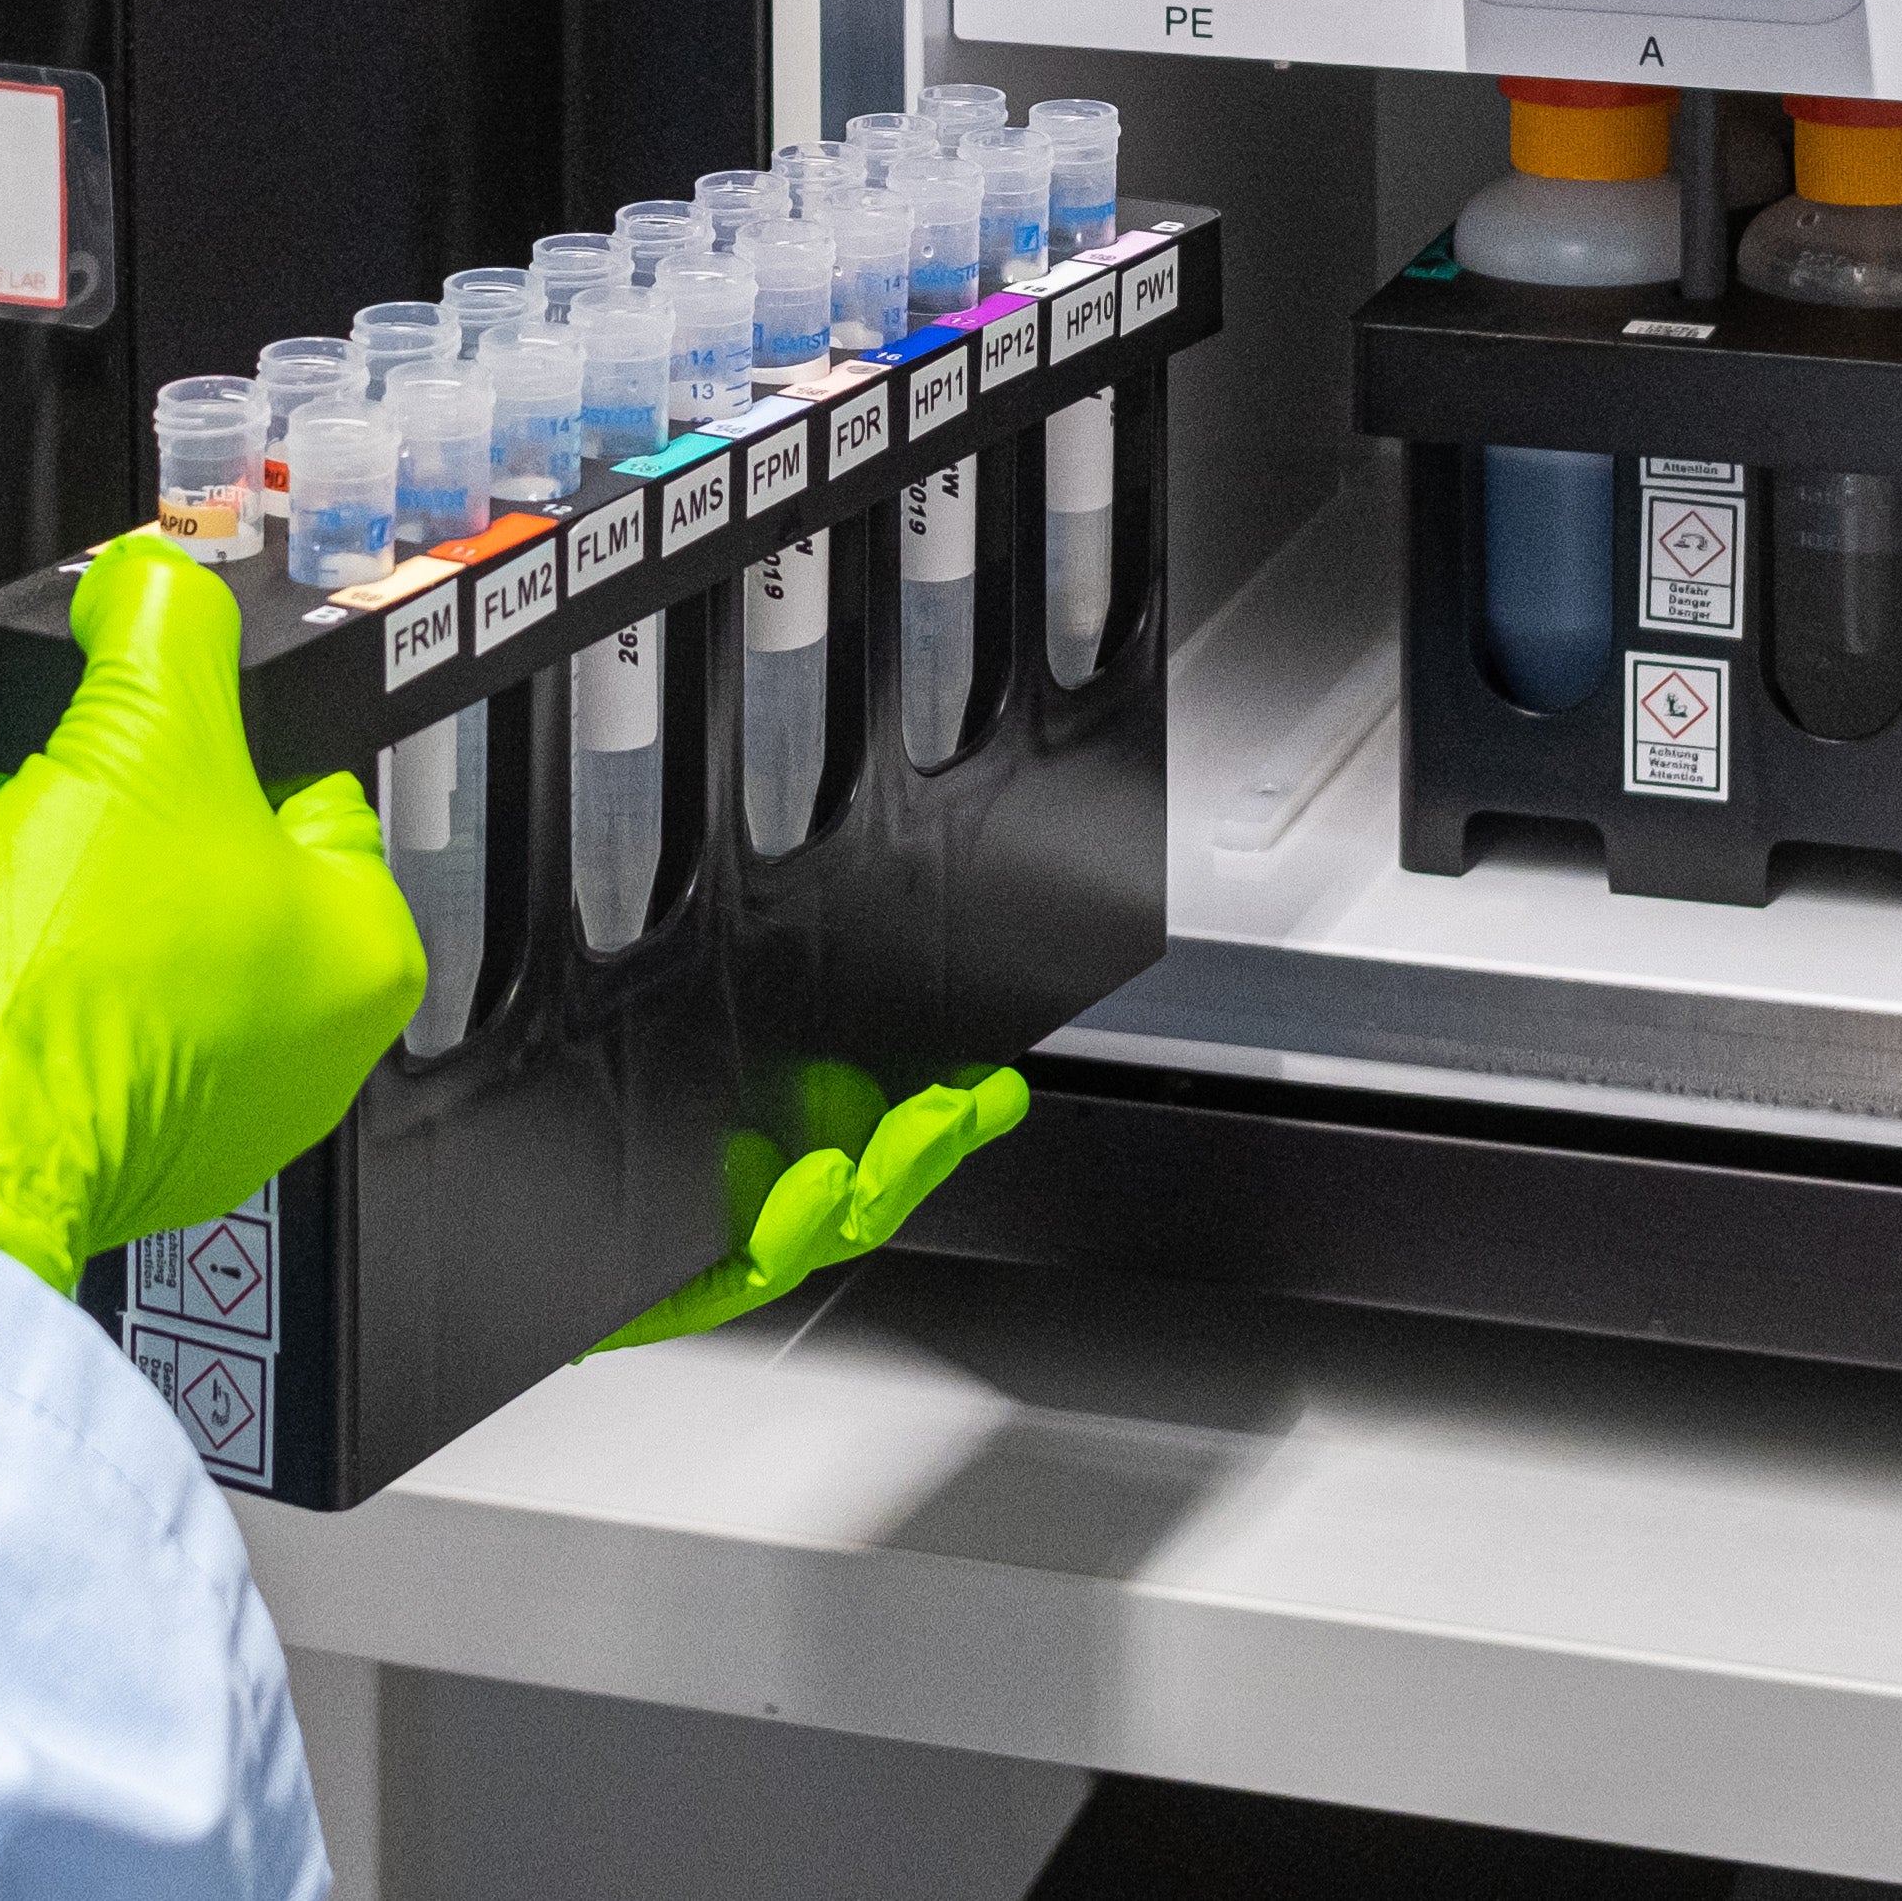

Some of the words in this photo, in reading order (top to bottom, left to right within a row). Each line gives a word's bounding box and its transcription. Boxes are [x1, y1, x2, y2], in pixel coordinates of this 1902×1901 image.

[1165, 6, 1213, 38] PE
[1639, 36, 1664, 67] A
[9, 271, 46, 290] LAB
[1136, 264, 1174, 311] PW1
[1067, 291, 1114, 340] HP10
[691, 350, 715, 366] 14
[876, 351, 903, 361] 16
[985, 323, 1035, 372] HP12
[692, 383, 714, 399] 13
[915, 366, 963, 419] HP11
[837, 405, 881, 457] FDR
[753, 443, 800, 495] FPM
[1662, 461, 1718, 477] Attention
[671, 476, 724, 534] AMS
[159, 512, 198, 536] APID
[577, 509, 640, 572] FLM1
[484, 562, 552, 629] FLM2
[1668, 581, 1709, 597] Gefahr
[1668, 595, 1712, 610] Danger
[1668, 606, 1711, 621] Danger
[394, 603, 451, 665] FRM
[1649, 746, 1699, 761] Achtung
[1649, 758, 1697, 773] Warning
[1649, 769, 1703, 784] Attention
[154, 1229, 165, 1284] arning
[166, 1227, 177, 1288] chtung
